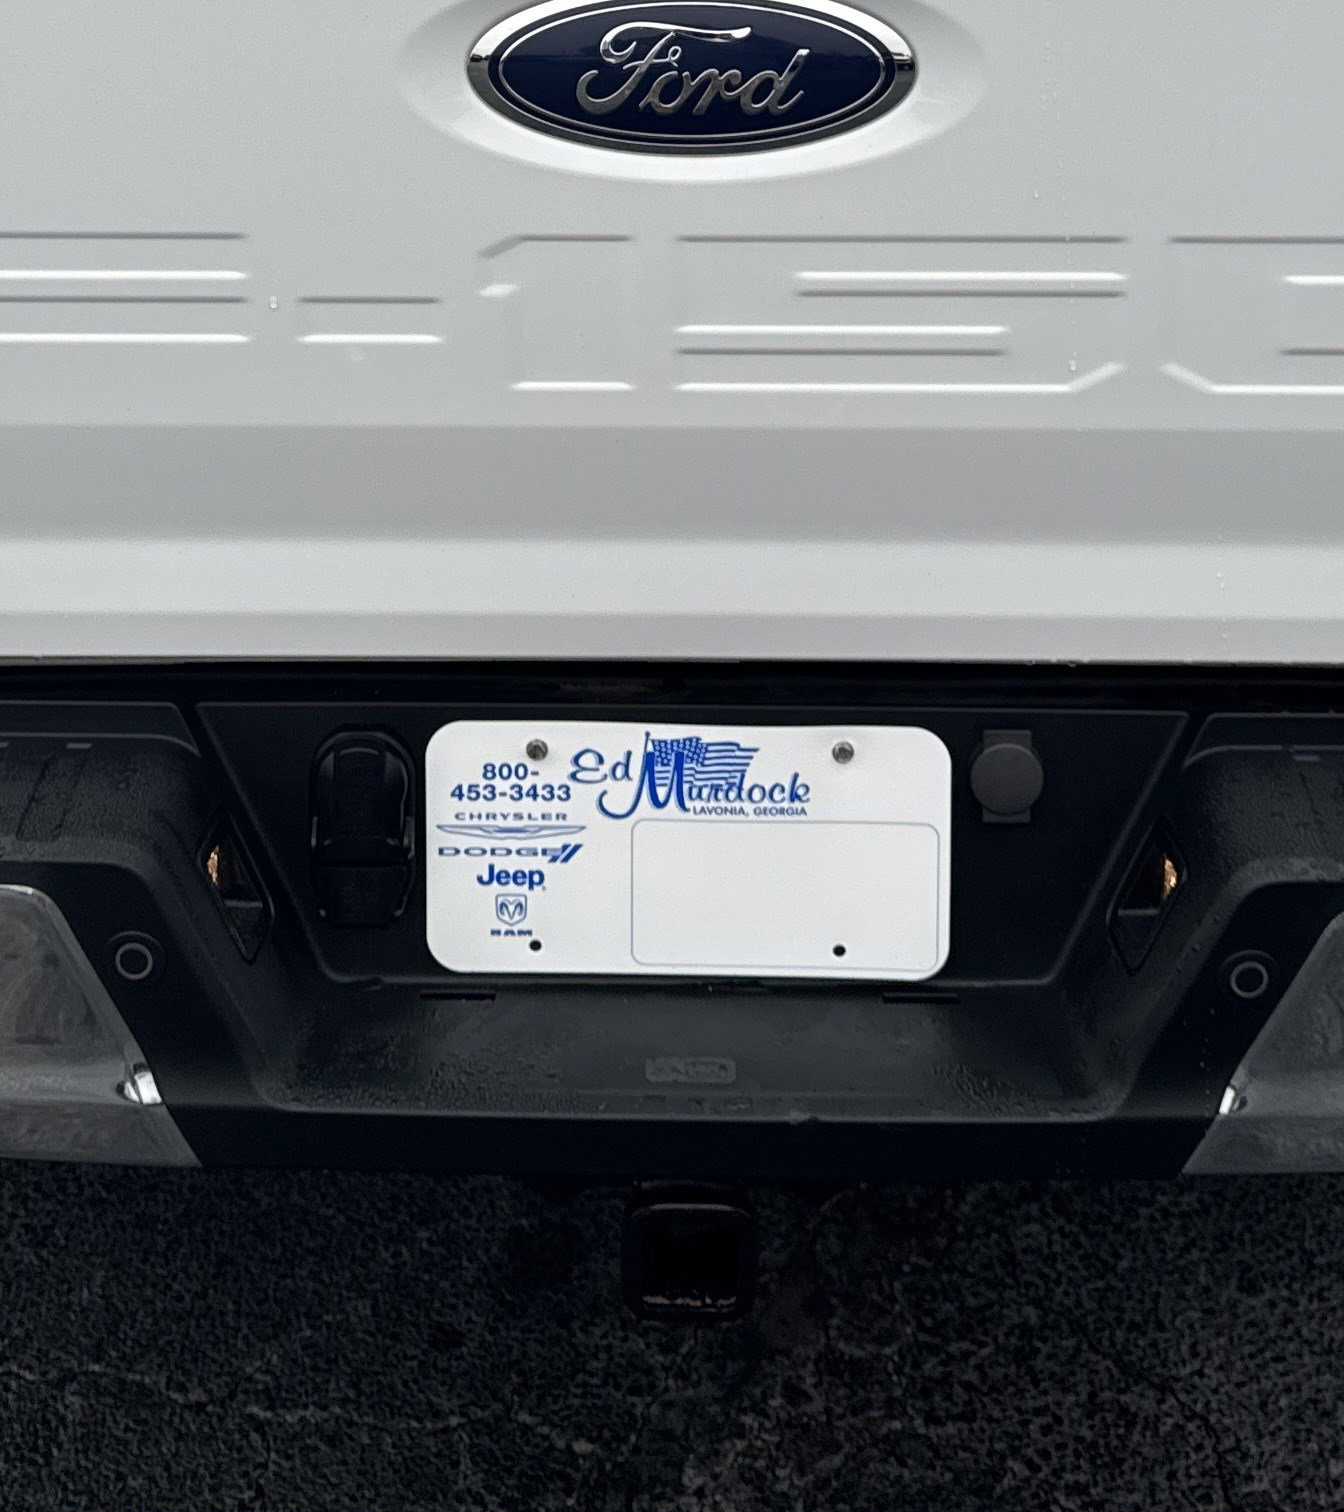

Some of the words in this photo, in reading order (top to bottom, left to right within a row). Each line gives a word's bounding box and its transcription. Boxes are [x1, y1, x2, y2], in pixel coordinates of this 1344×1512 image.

[576, 21, 810, 116] Ford
[482, 762, 540, 780] 800-
[568, 748, 634, 785] Ed
[450, 783, 572, 802] 453-3433
[596, 750, 811, 820] Murdock
[454, 811, 568, 821] CHRYSLER
[692, 805, 750, 817] LAVONIA,
[752, 805, 808, 817] GEORGIA
[476, 863, 546, 890] Jeep
